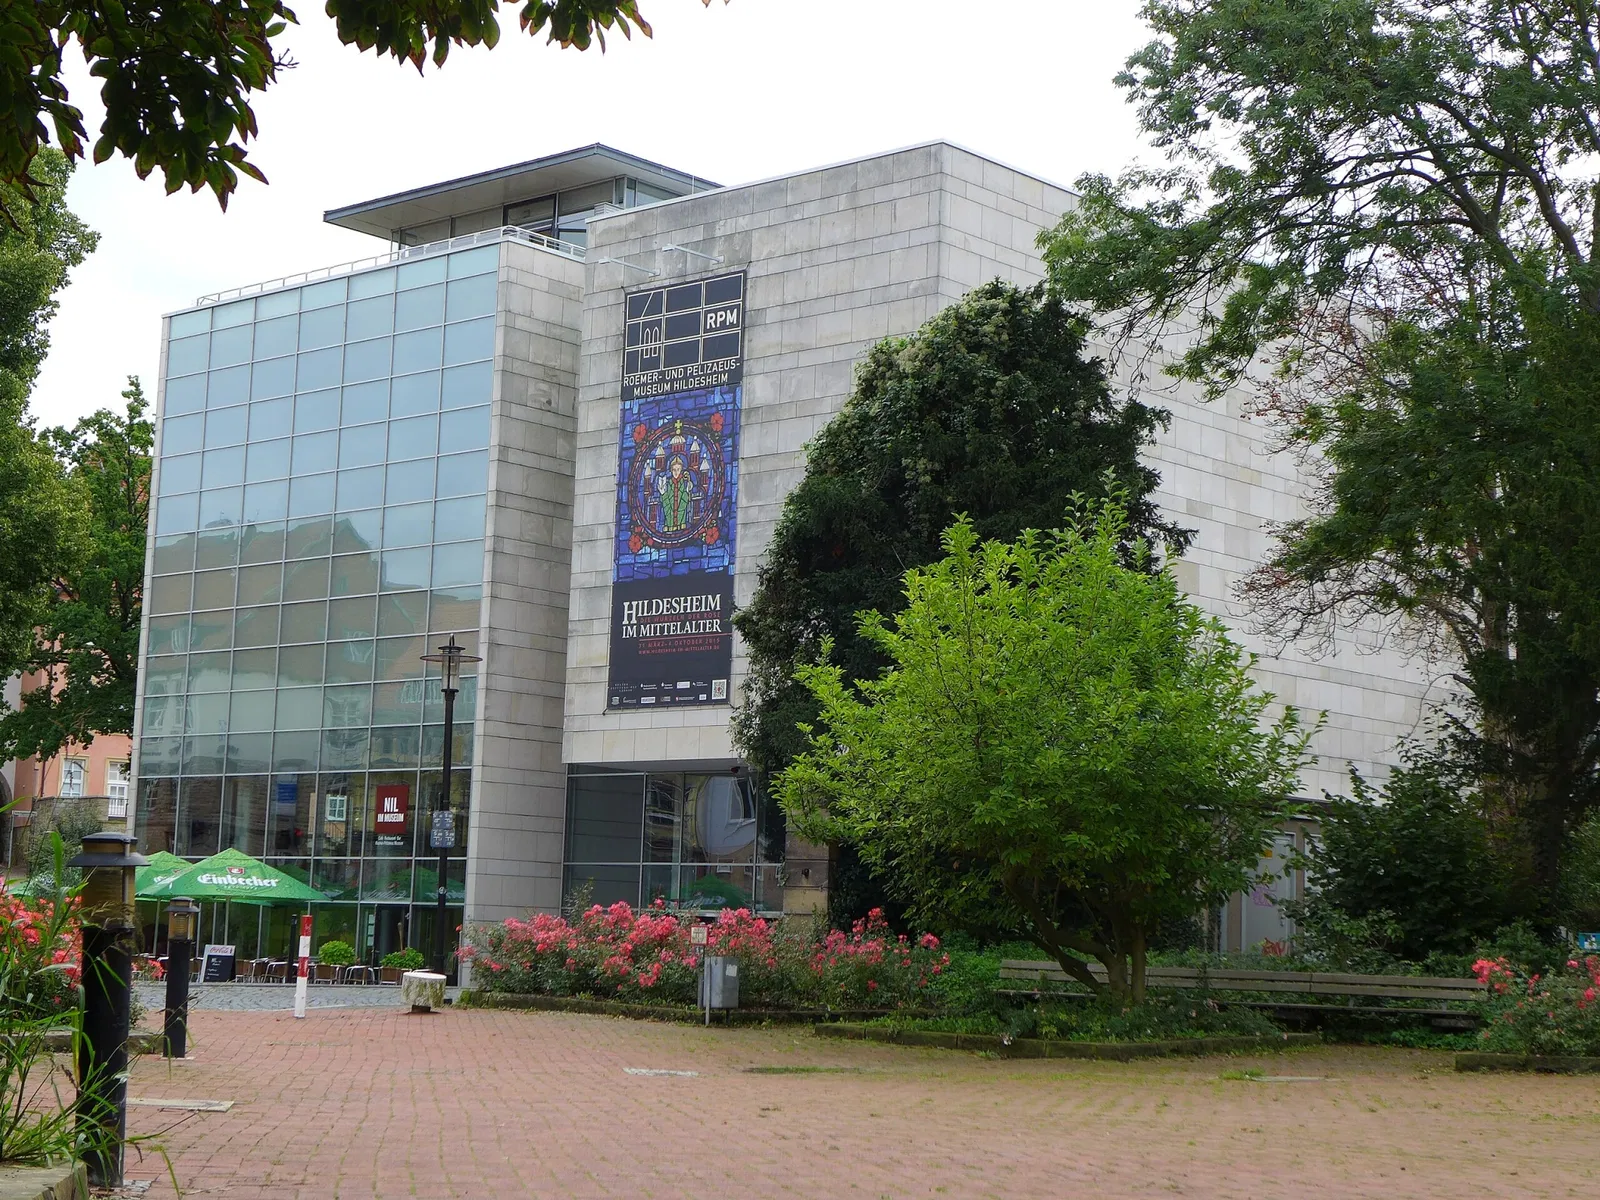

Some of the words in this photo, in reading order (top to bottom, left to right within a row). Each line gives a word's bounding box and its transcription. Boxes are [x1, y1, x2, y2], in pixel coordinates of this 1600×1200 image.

[706, 308, 738, 329] RPM
[624, 372, 662, 387] ROEMER-
[666, 368, 684, 380] UND
[687, 359, 740, 376] PELIZAEUS-
[634, 382, 670, 397] MUSEUM
[674, 373, 728, 391] HILDESHEIM
[622, 594, 721, 624] HILDESHEIM
[622, 626, 637, 638] IM
[640, 619, 722, 637] MITTELALTER
[384, 797, 399, 812] NIL
[377, 813, 384, 822] IM
[384, 813, 404, 822] MUSEUM
